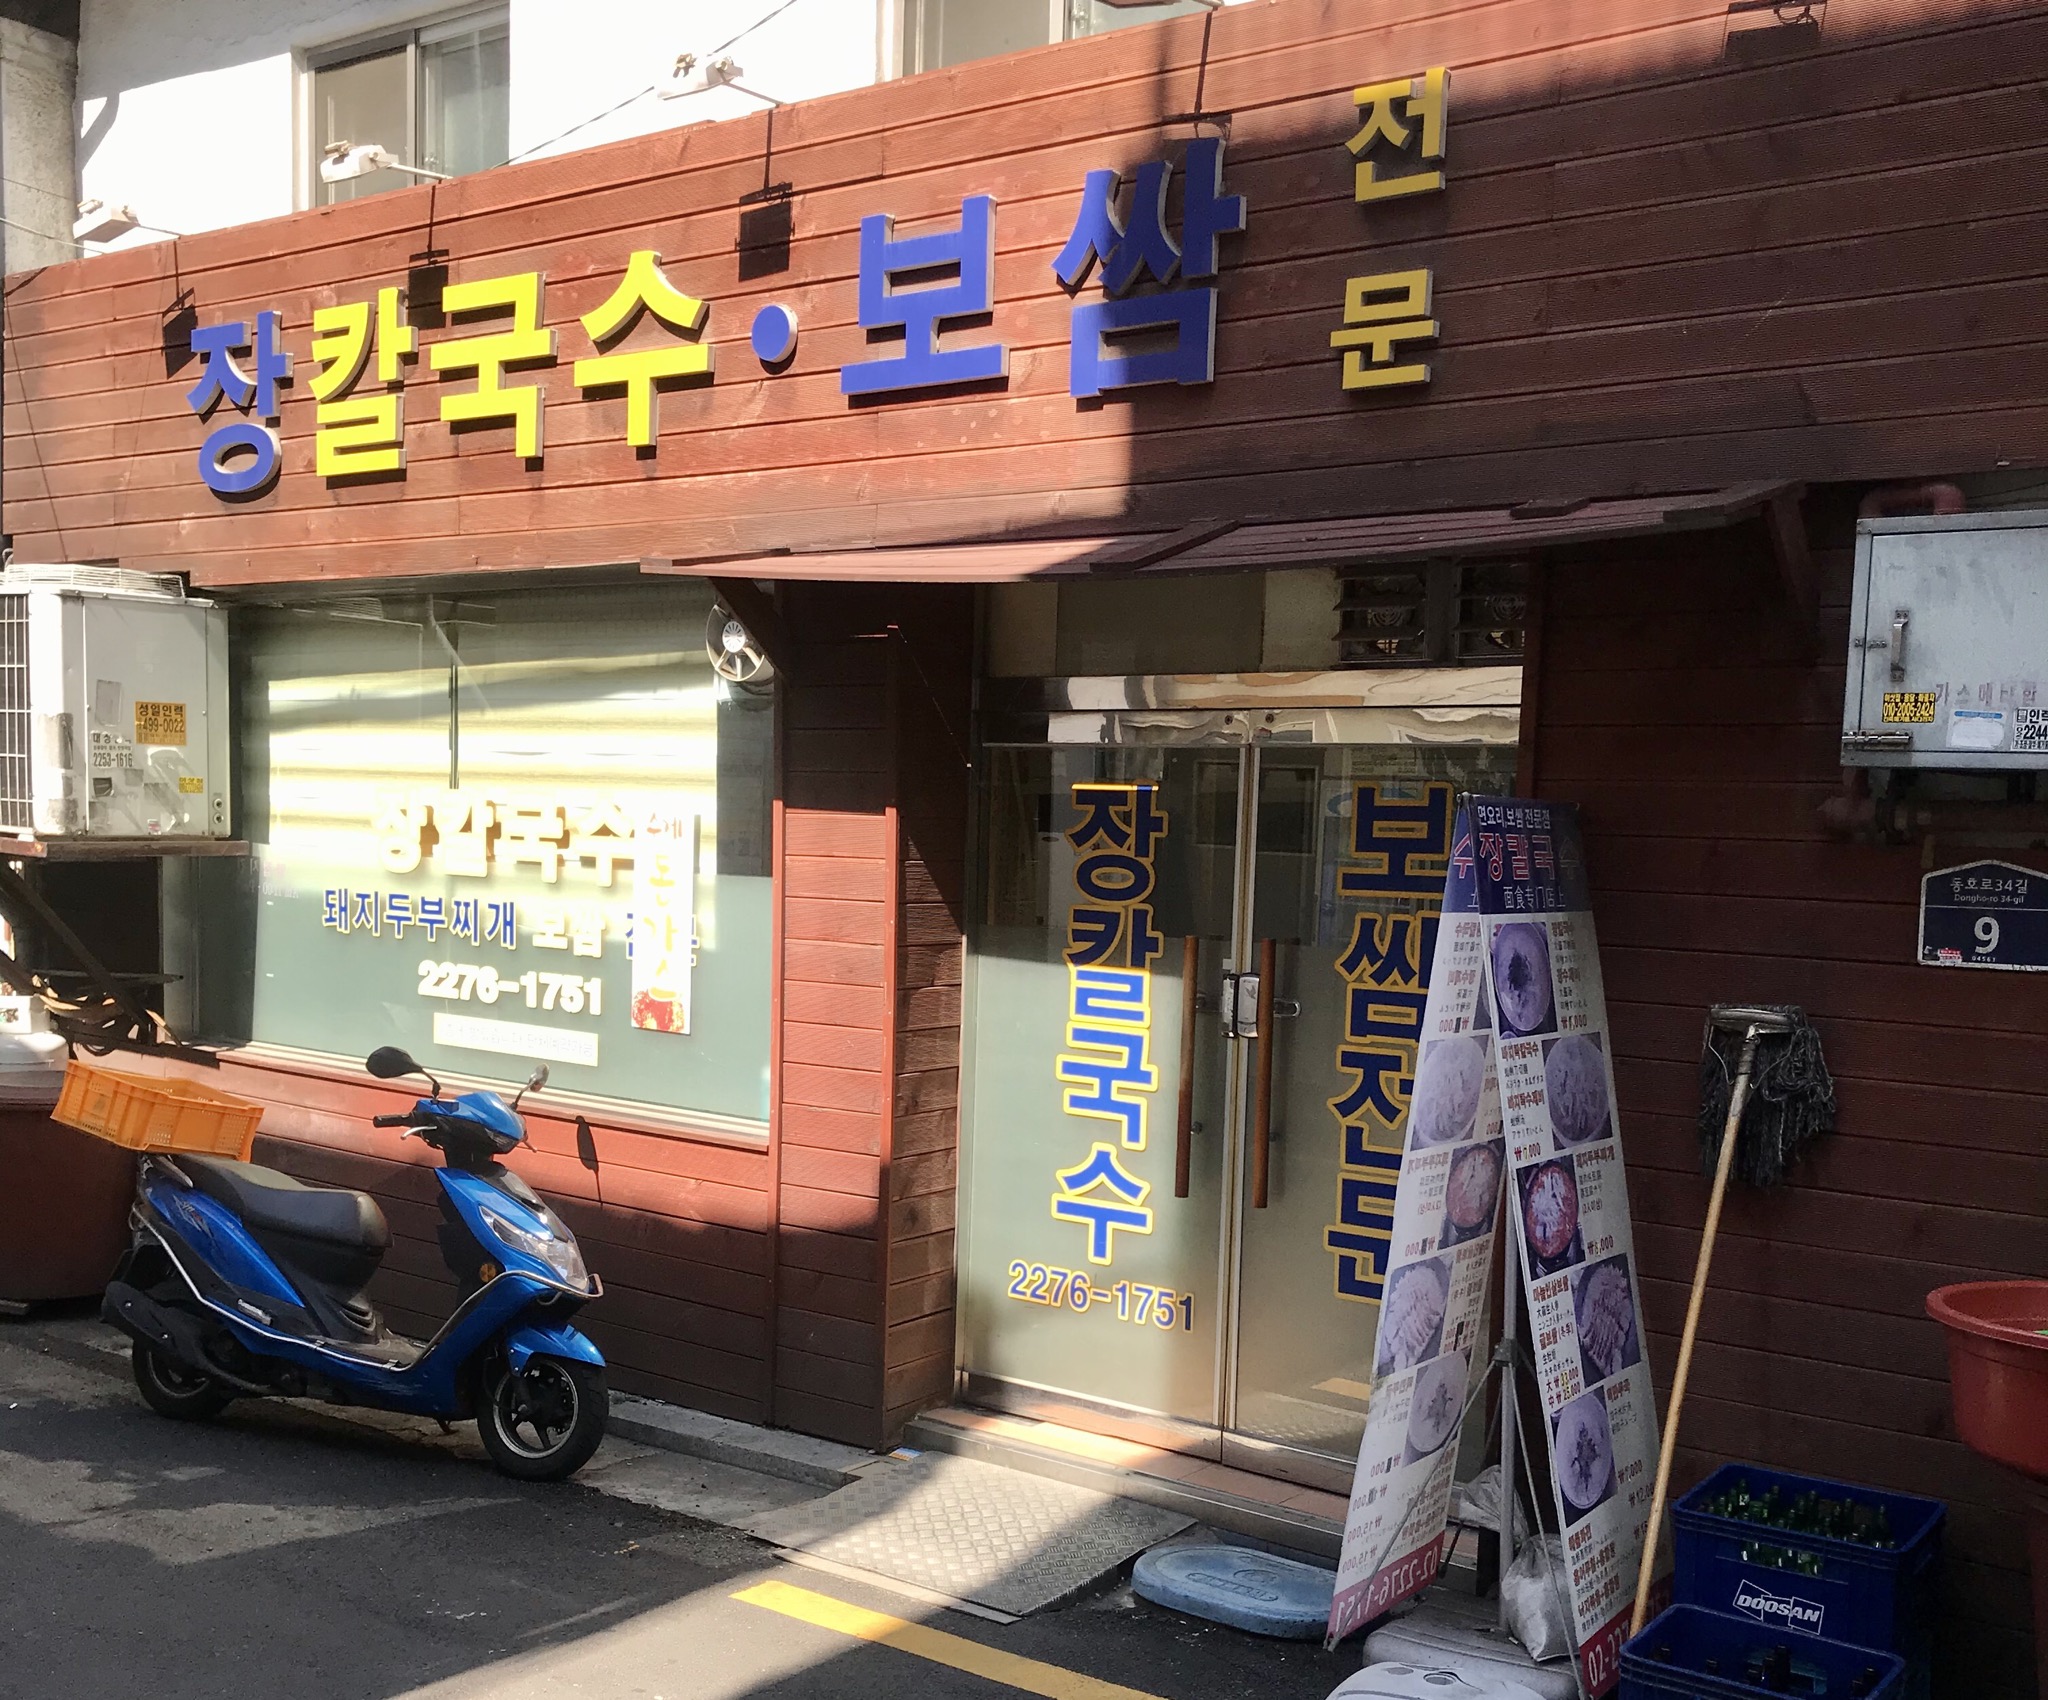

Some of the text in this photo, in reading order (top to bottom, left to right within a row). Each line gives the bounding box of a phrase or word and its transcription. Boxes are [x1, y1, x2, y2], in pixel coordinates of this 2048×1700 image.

[841, 137, 1247, 400] 보쌈
[138, 704, 184, 718] 성일인력
[93, 752, 133, 768] 2253-1616
[1950, 877, 2028, 895] 동호로34길
[323, 887, 517, 952] 돼지두부찌개
[1974, 916, 2000, 954] 9
[417, 959, 603, 1017] 2276-1751
[1052, 783, 1169, 1266] 장칼국수
[1008, 1259, 1195, 1333] 2276-1751
[1736, 1594, 1821, 1623] DOOSAN
